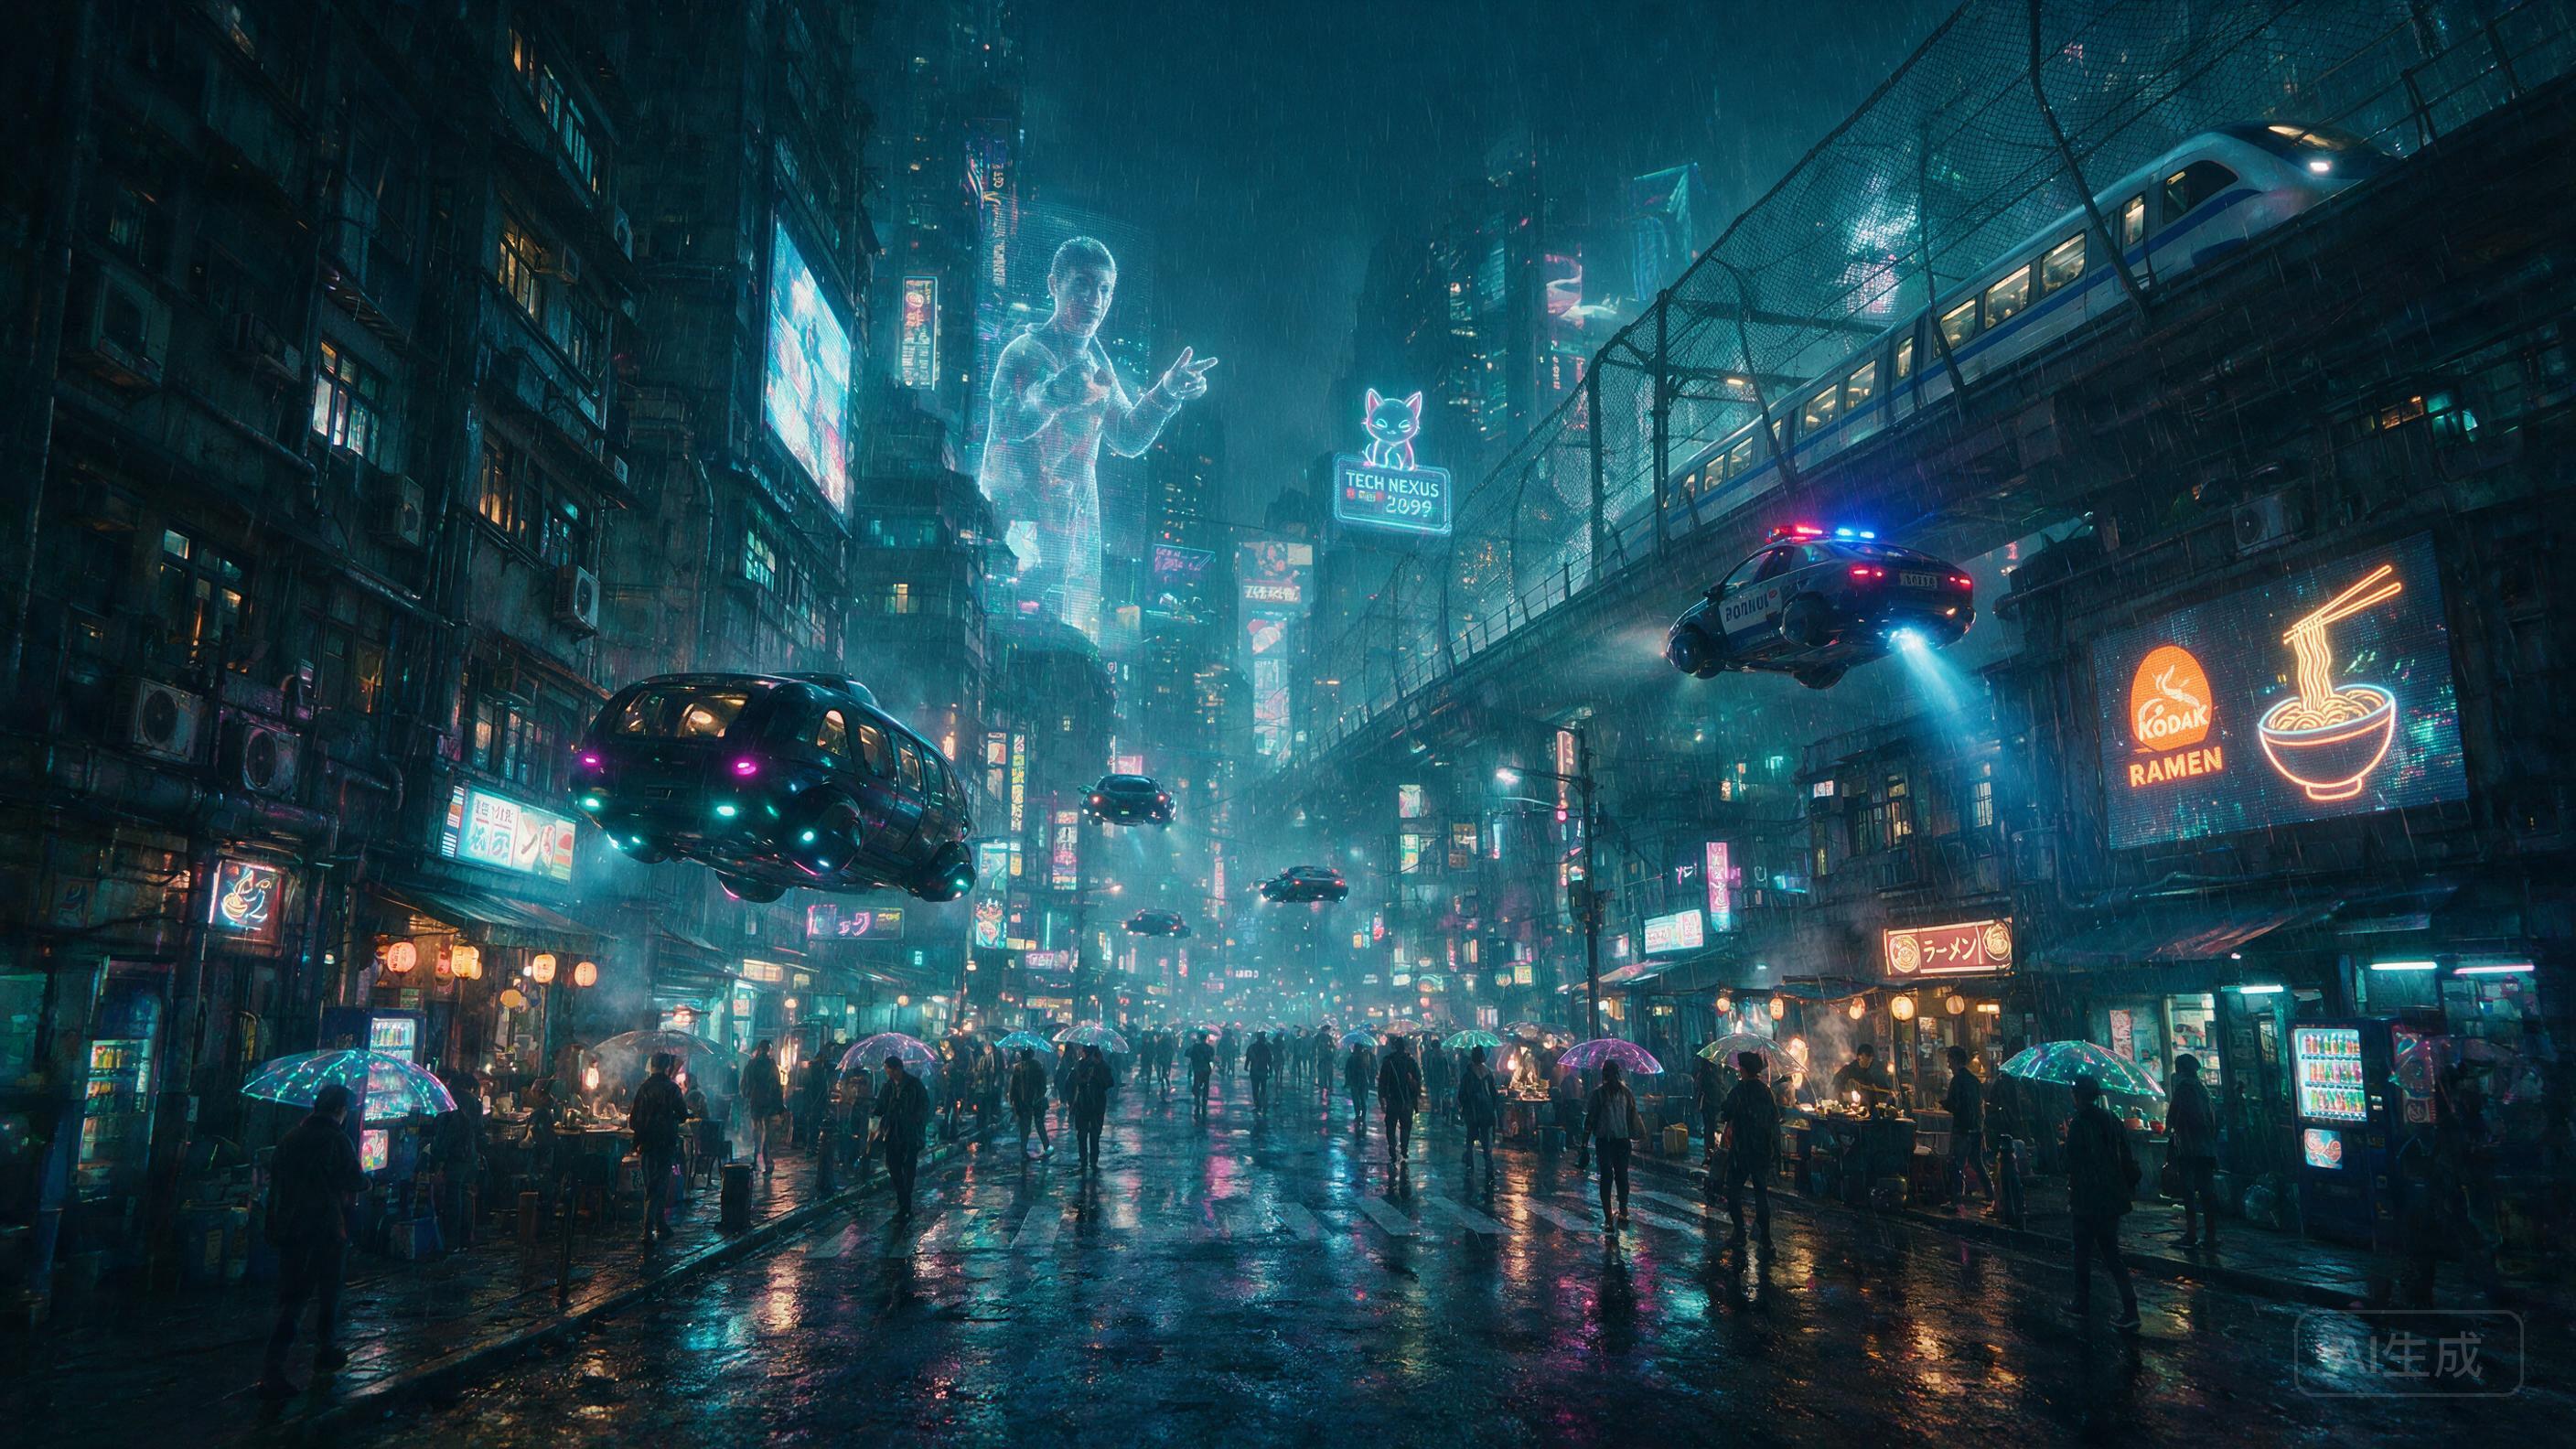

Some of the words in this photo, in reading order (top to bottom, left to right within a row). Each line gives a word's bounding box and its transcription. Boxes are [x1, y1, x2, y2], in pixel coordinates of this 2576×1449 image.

[1346, 471, 1384, 490] TECH
[1389, 478, 1439, 498] NEXUS
[1386, 495, 1433, 518] 2099
[2138, 703, 2209, 742] KODAK
[2129, 746, 2223, 788] RAMEN
[1923, 936, 1977, 963] ラーメン
